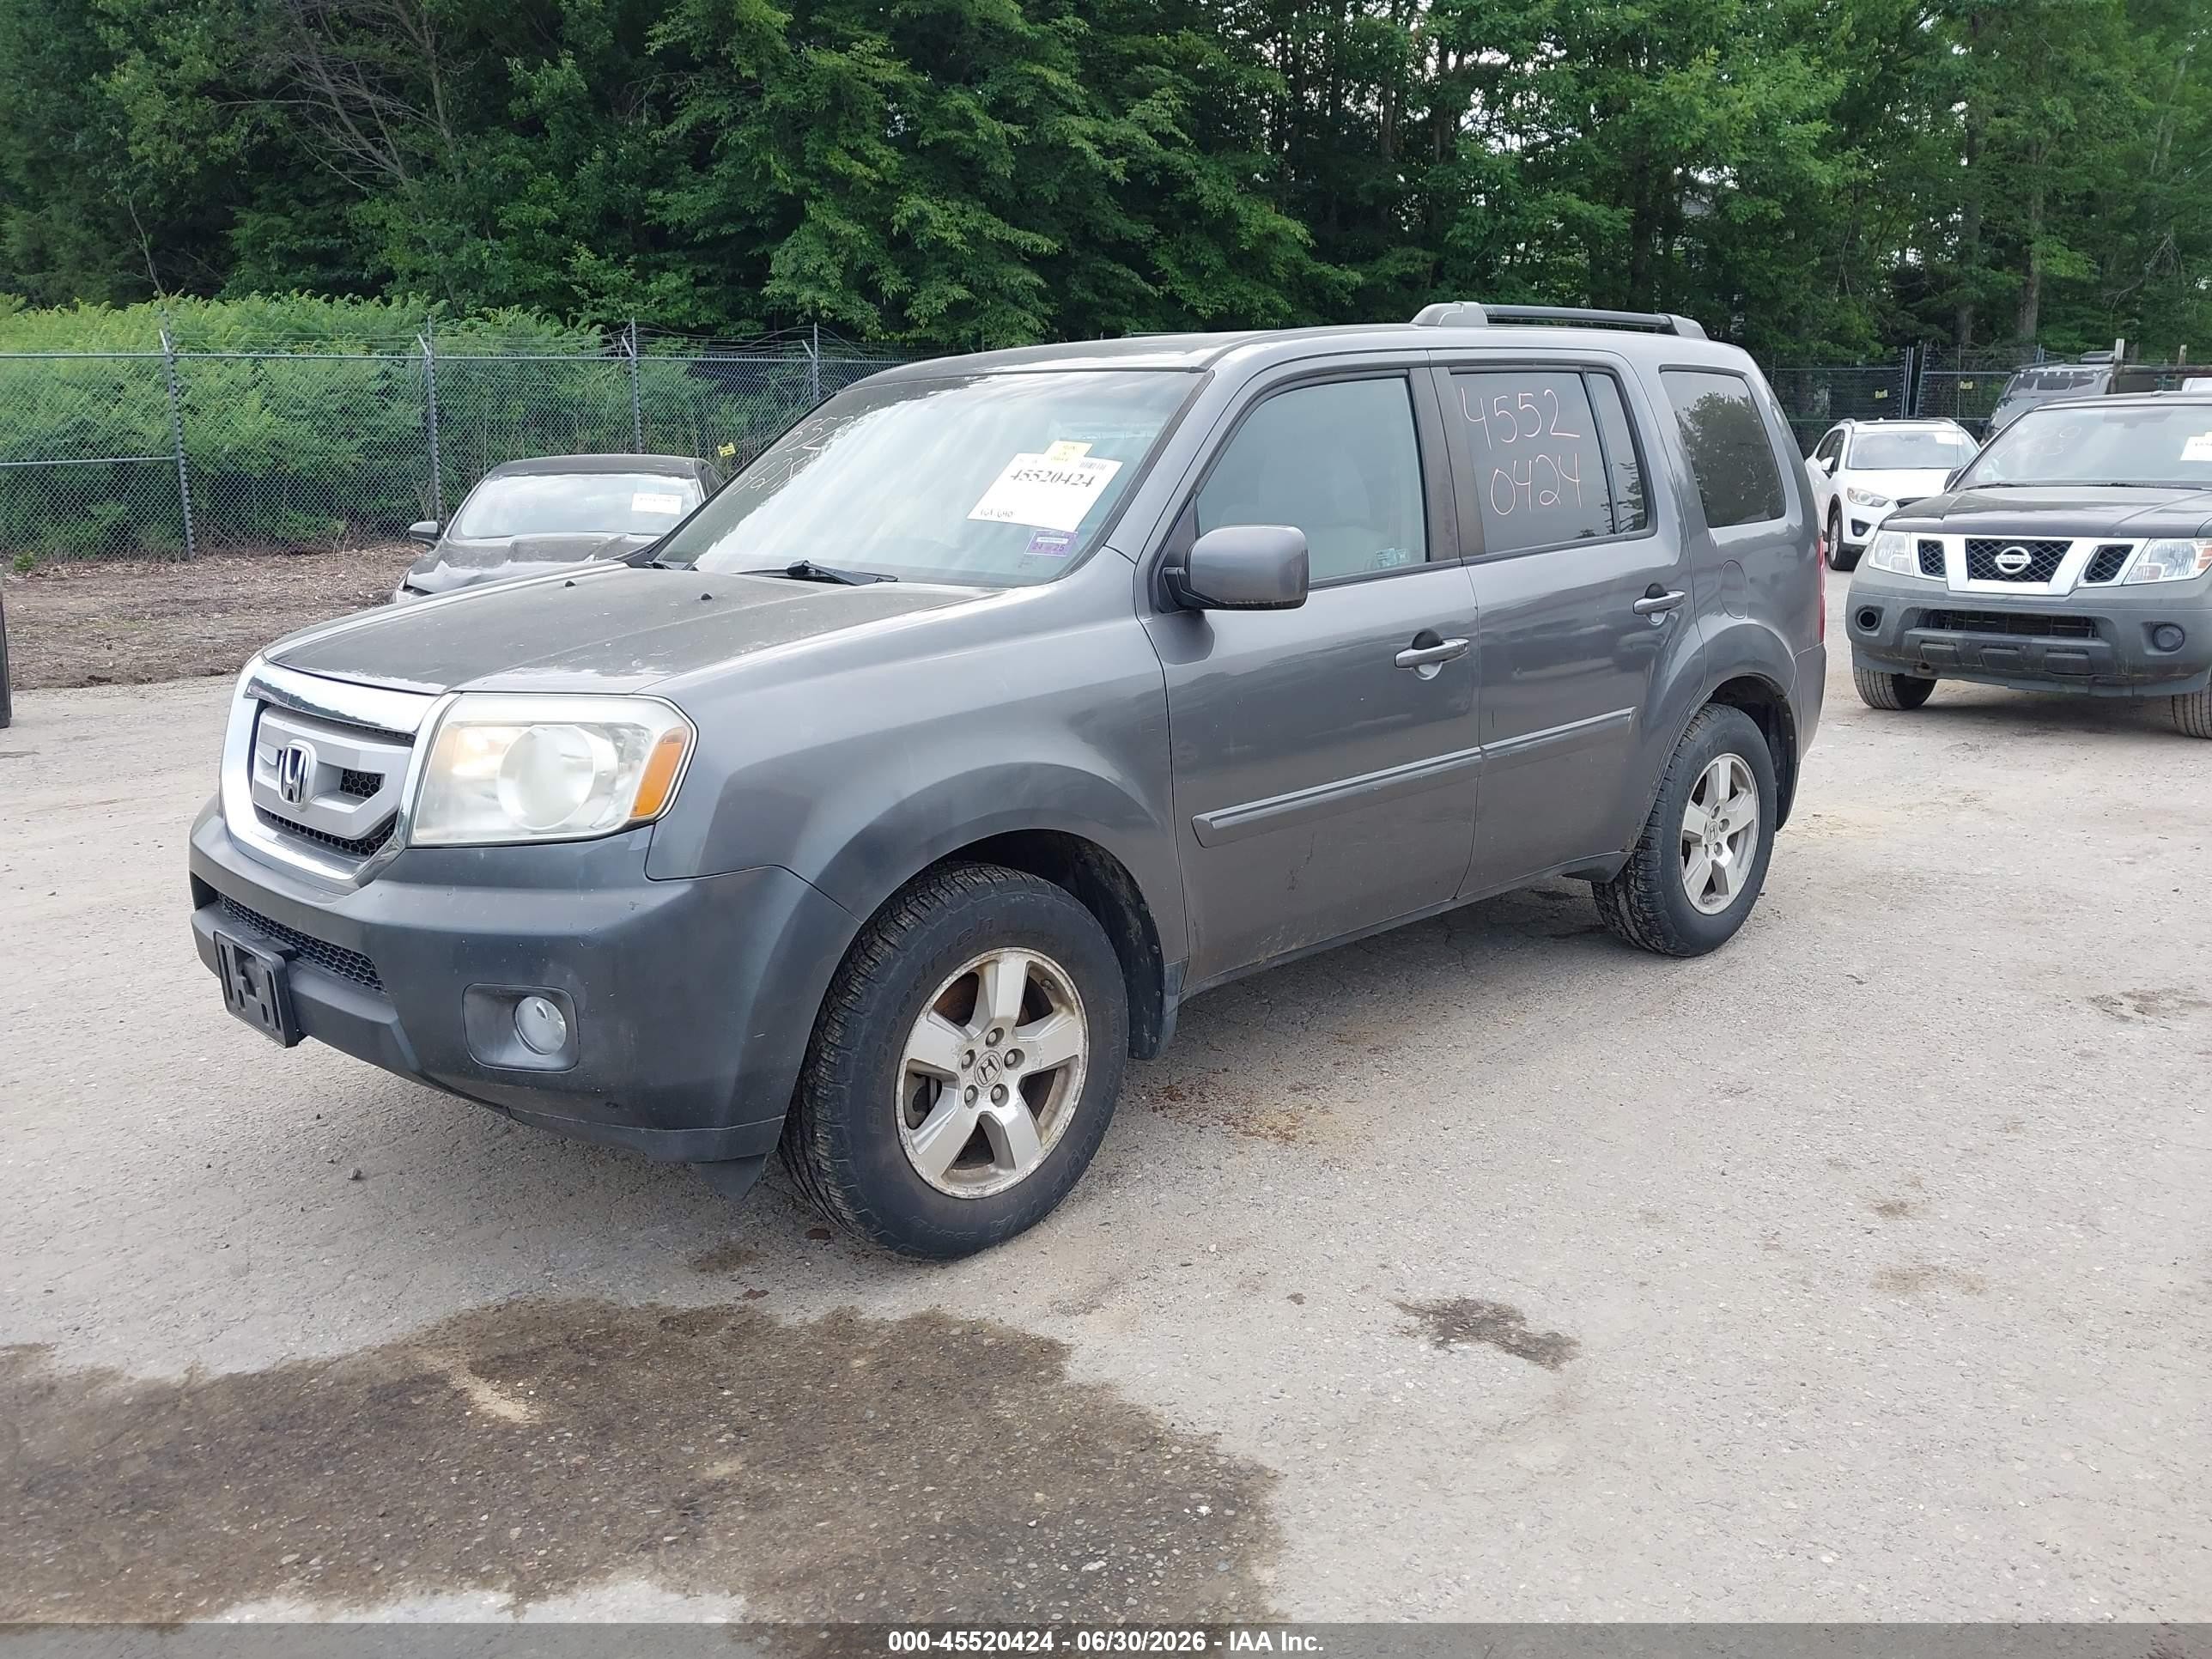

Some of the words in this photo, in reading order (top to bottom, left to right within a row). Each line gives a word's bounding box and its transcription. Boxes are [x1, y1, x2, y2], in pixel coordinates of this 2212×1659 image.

[1461, 386, 1580, 451] 4552
[1010, 469, 1095, 487] 45520424
[1490, 453, 1582, 515] 0424
